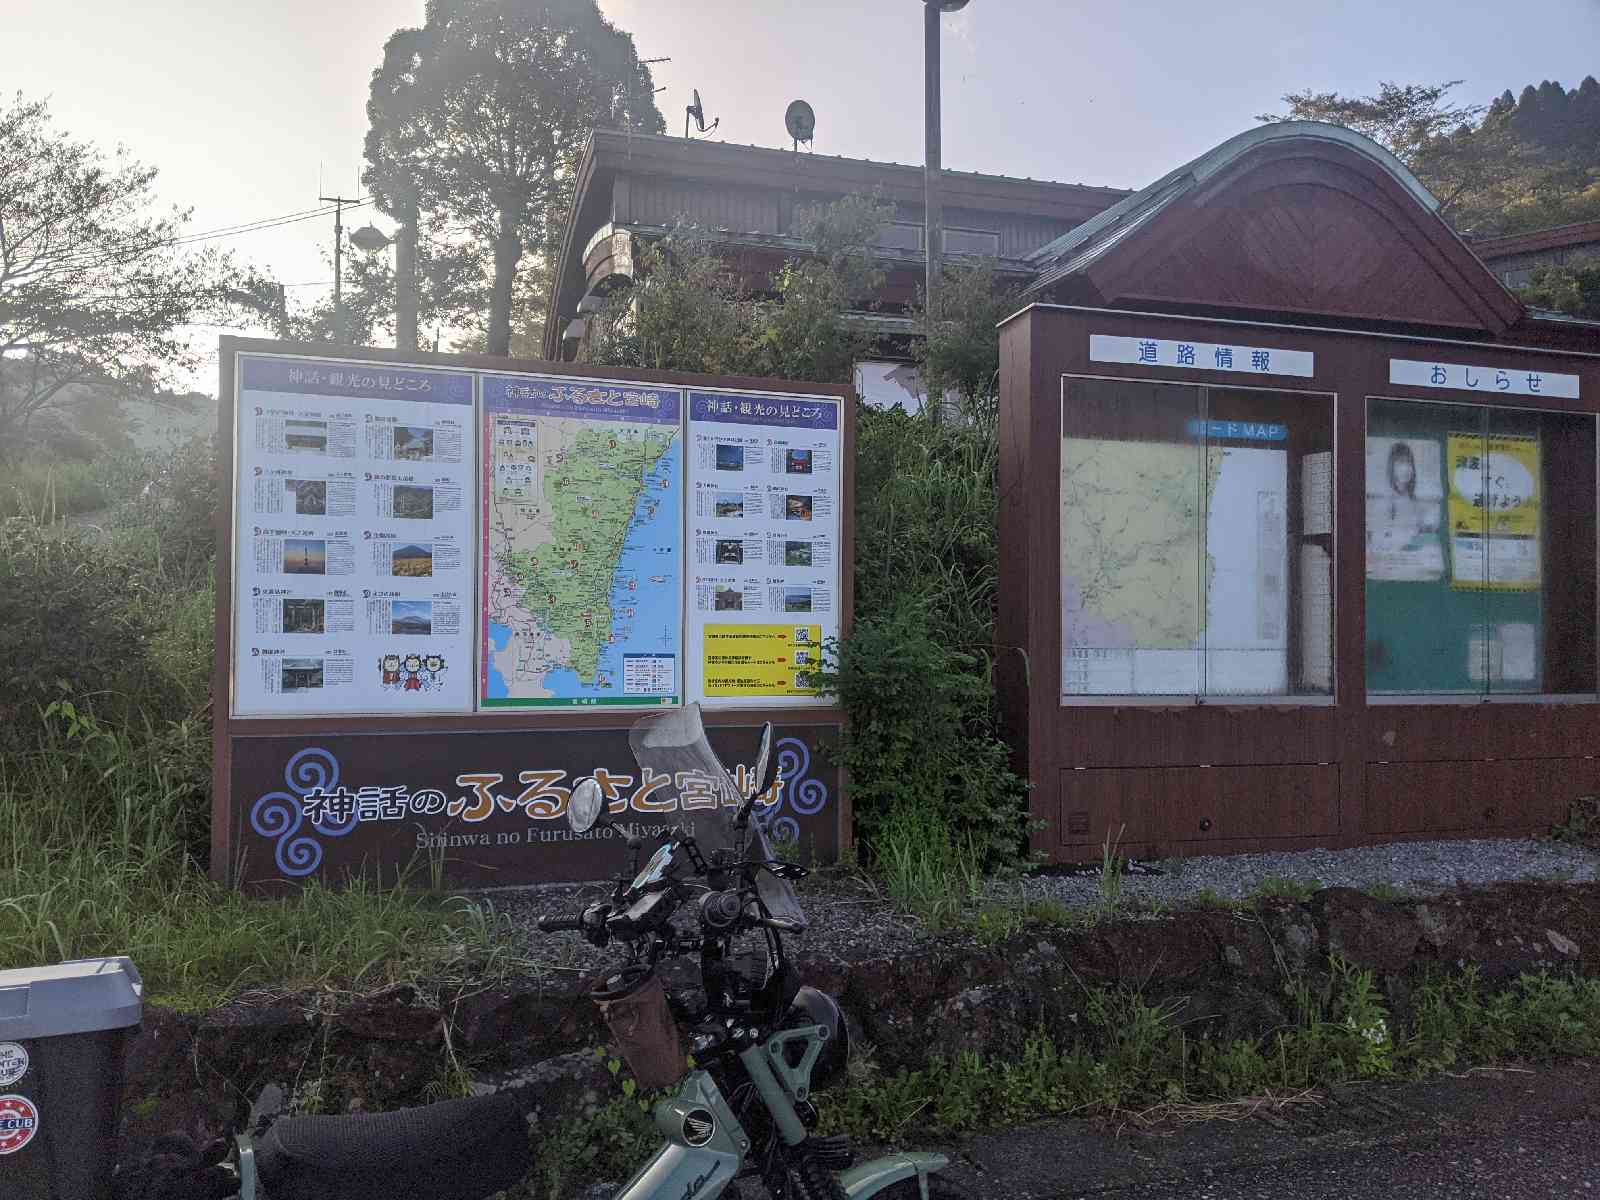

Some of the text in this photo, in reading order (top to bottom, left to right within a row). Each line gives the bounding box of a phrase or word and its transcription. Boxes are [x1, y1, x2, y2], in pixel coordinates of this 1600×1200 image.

[1138, 341, 1270, 372] 道路情報
[288, 367, 432, 392] 神話・観光の見どころ
[1430, 364, 1543, 393] おしらせ
[707, 399, 823, 419] 神話・観光の見どころ
[415, 831, 491, 849] Shinwa
[496, 831, 521, 845] no
[527, 824, 613, 844] Furusato
